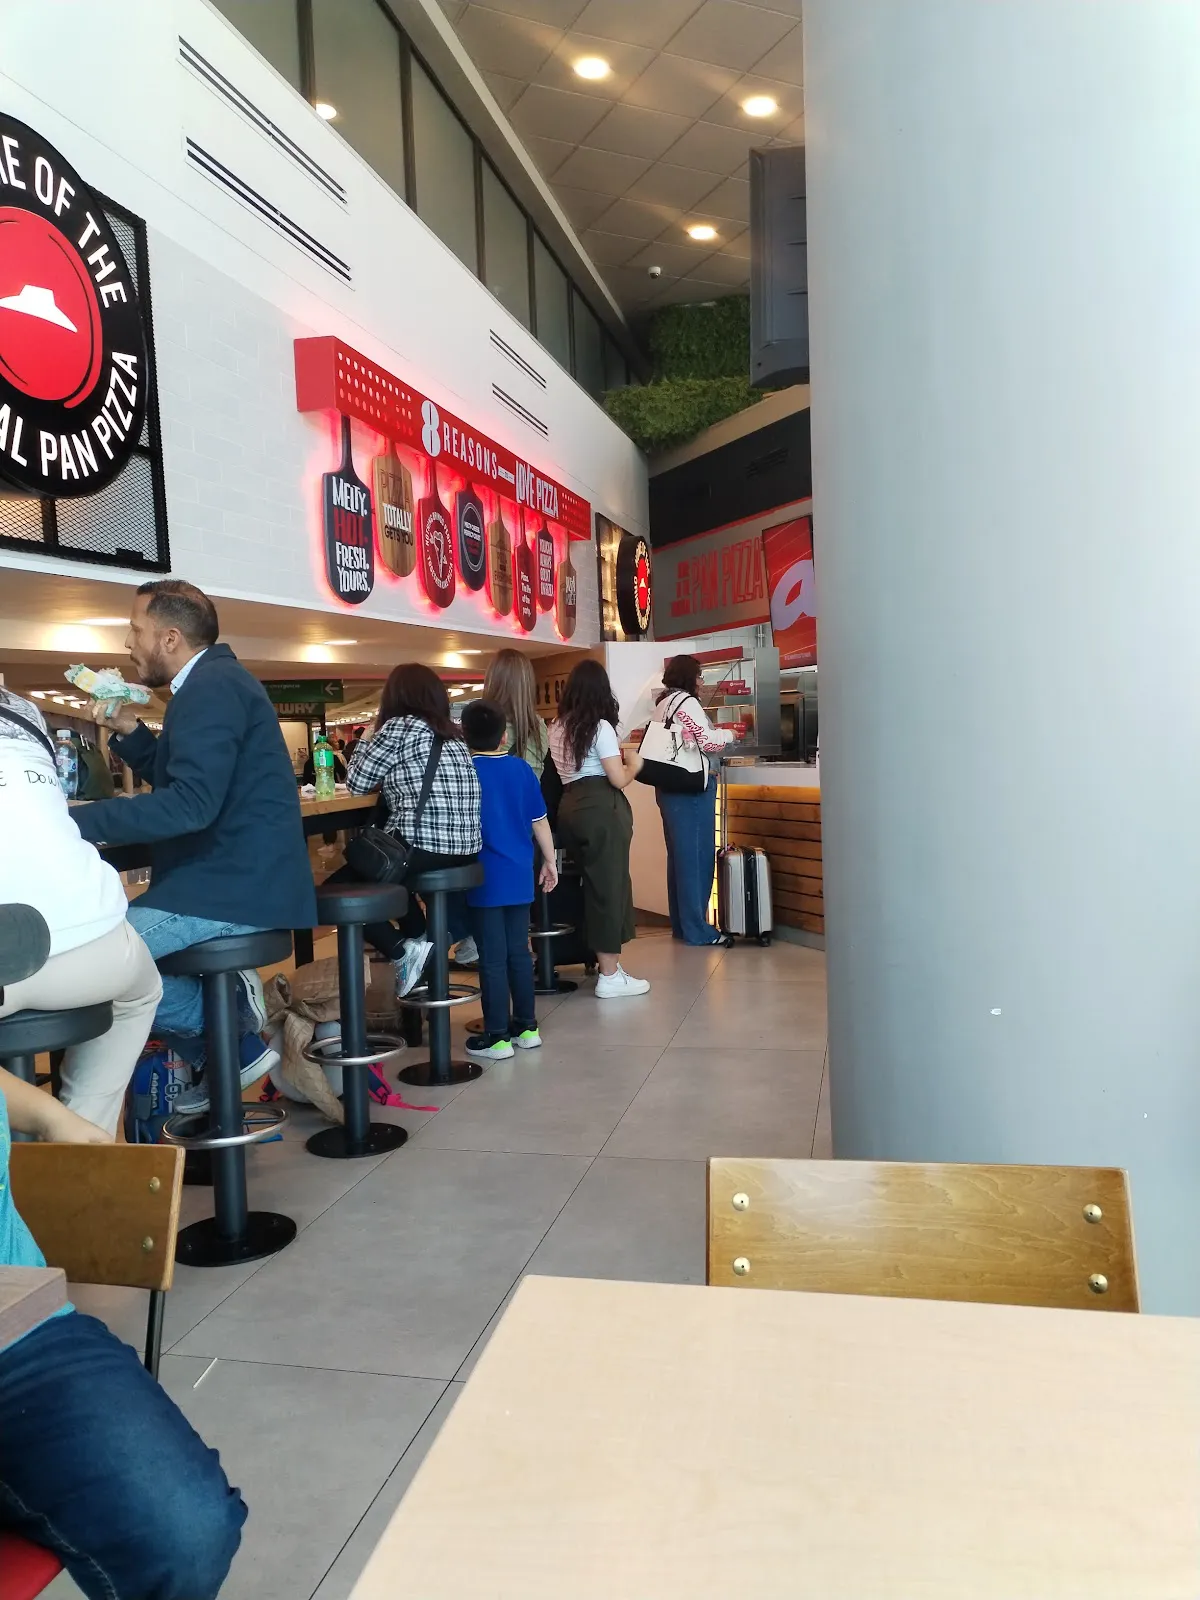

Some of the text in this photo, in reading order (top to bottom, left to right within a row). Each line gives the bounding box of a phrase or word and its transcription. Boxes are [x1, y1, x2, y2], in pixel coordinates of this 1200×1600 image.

[34, 156, 76, 217] OF
[78, 211, 127, 309] THE
[39, 429, 99, 481] PAN
[93, 351, 138, 461] PIZZA
[421, 400, 559, 519] 8 REASONS LOVE PIZZA
[332, 476, 368, 517] MELTY.
[333, 507, 369, 546] HOT.
[382, 502, 412, 533] TOTALLY
[384, 524, 414, 547] GETS YOU
[335, 541, 370, 570] FRESH.
[691, 549, 719, 615] PAN
[721, 535, 763, 606] PIZZA
[337, 566, 371, 593] YOURS.
